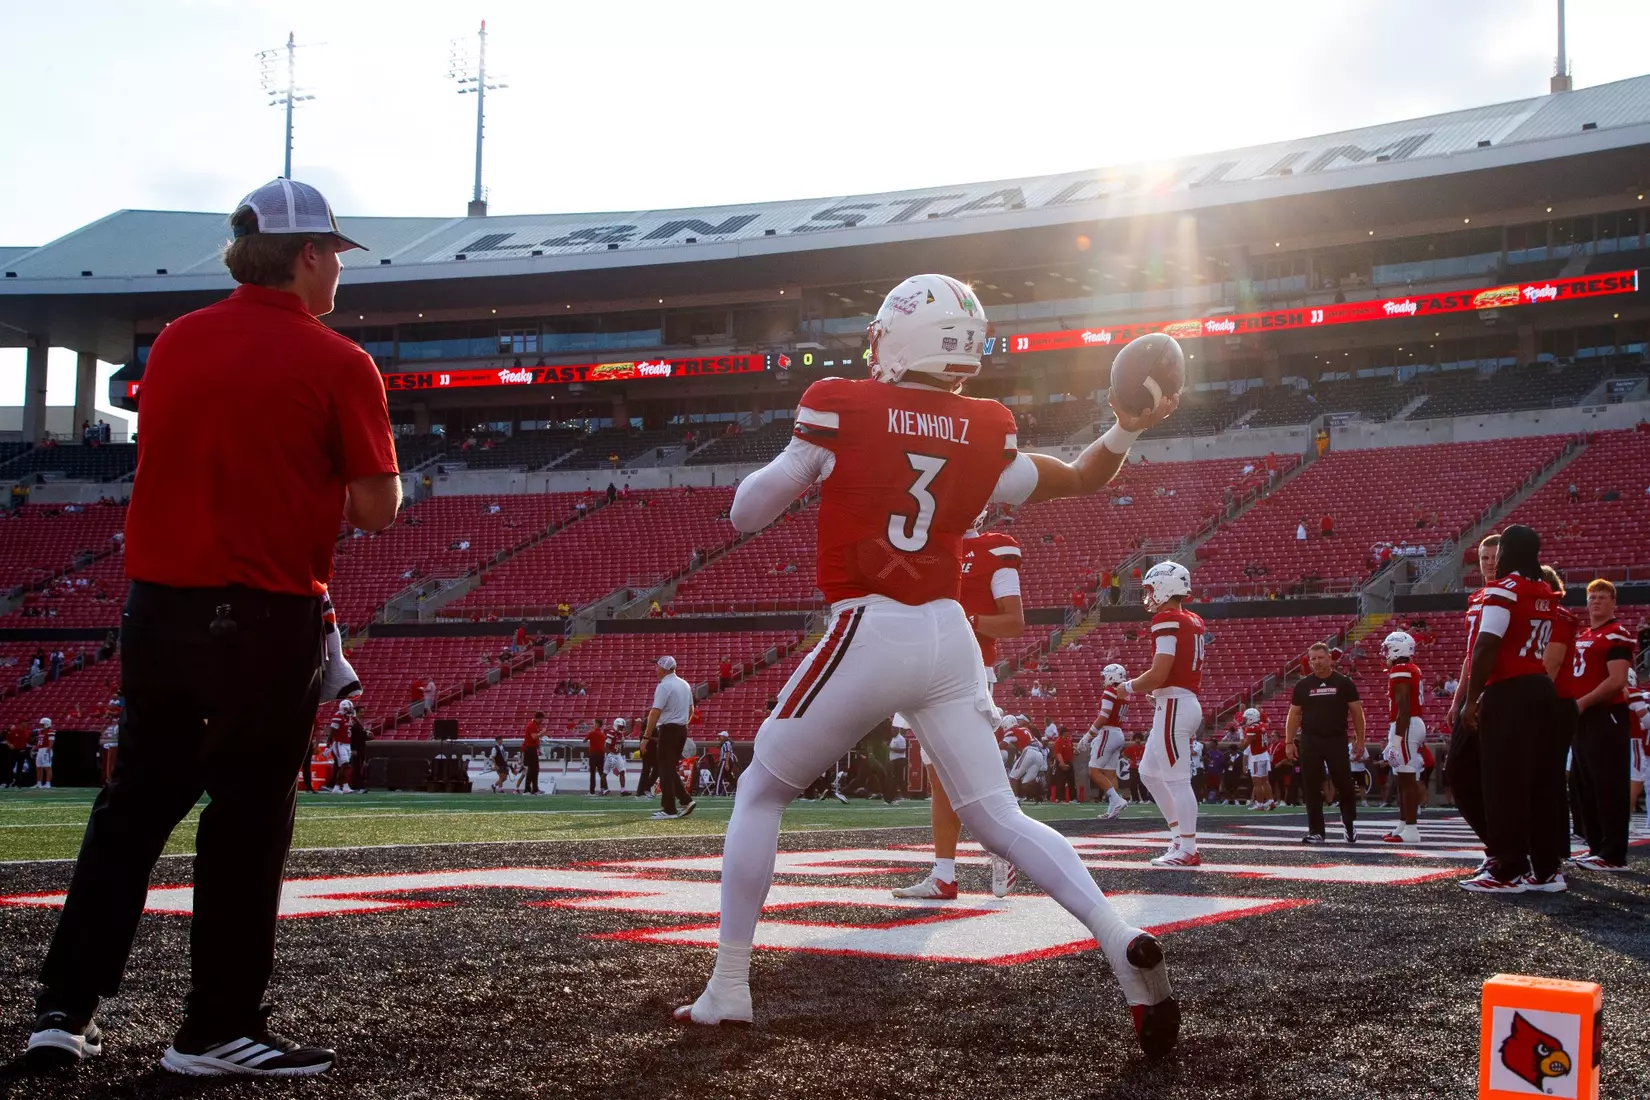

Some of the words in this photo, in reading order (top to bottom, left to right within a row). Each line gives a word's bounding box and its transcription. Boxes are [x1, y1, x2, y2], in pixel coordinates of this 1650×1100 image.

[457, 212, 762, 253] L&N
[790, 132, 1434, 234] STADUM
[1523, 284, 1558, 300] Freaky
[1557, 275, 1636, 297] FRESH
[1383, 299, 1417, 315] Freaky
[1416, 294, 1473, 311] FAST
[1205, 319, 1236, 333] Freaky
[1235, 313, 1303, 329] FRESH
[1081, 330, 1112, 345] Freaky
[637, 361, 671, 377] Freaky
[670, 357, 750, 375] FRESH
[803, 353, 814, 366] 0
[384, 374, 433, 389] ESH
[498, 367, 533, 385] Freaky
[531, 366, 591, 382] FAST
[888, 408, 969, 445] KIENHOLZ
[887, 452, 948, 553] 3
